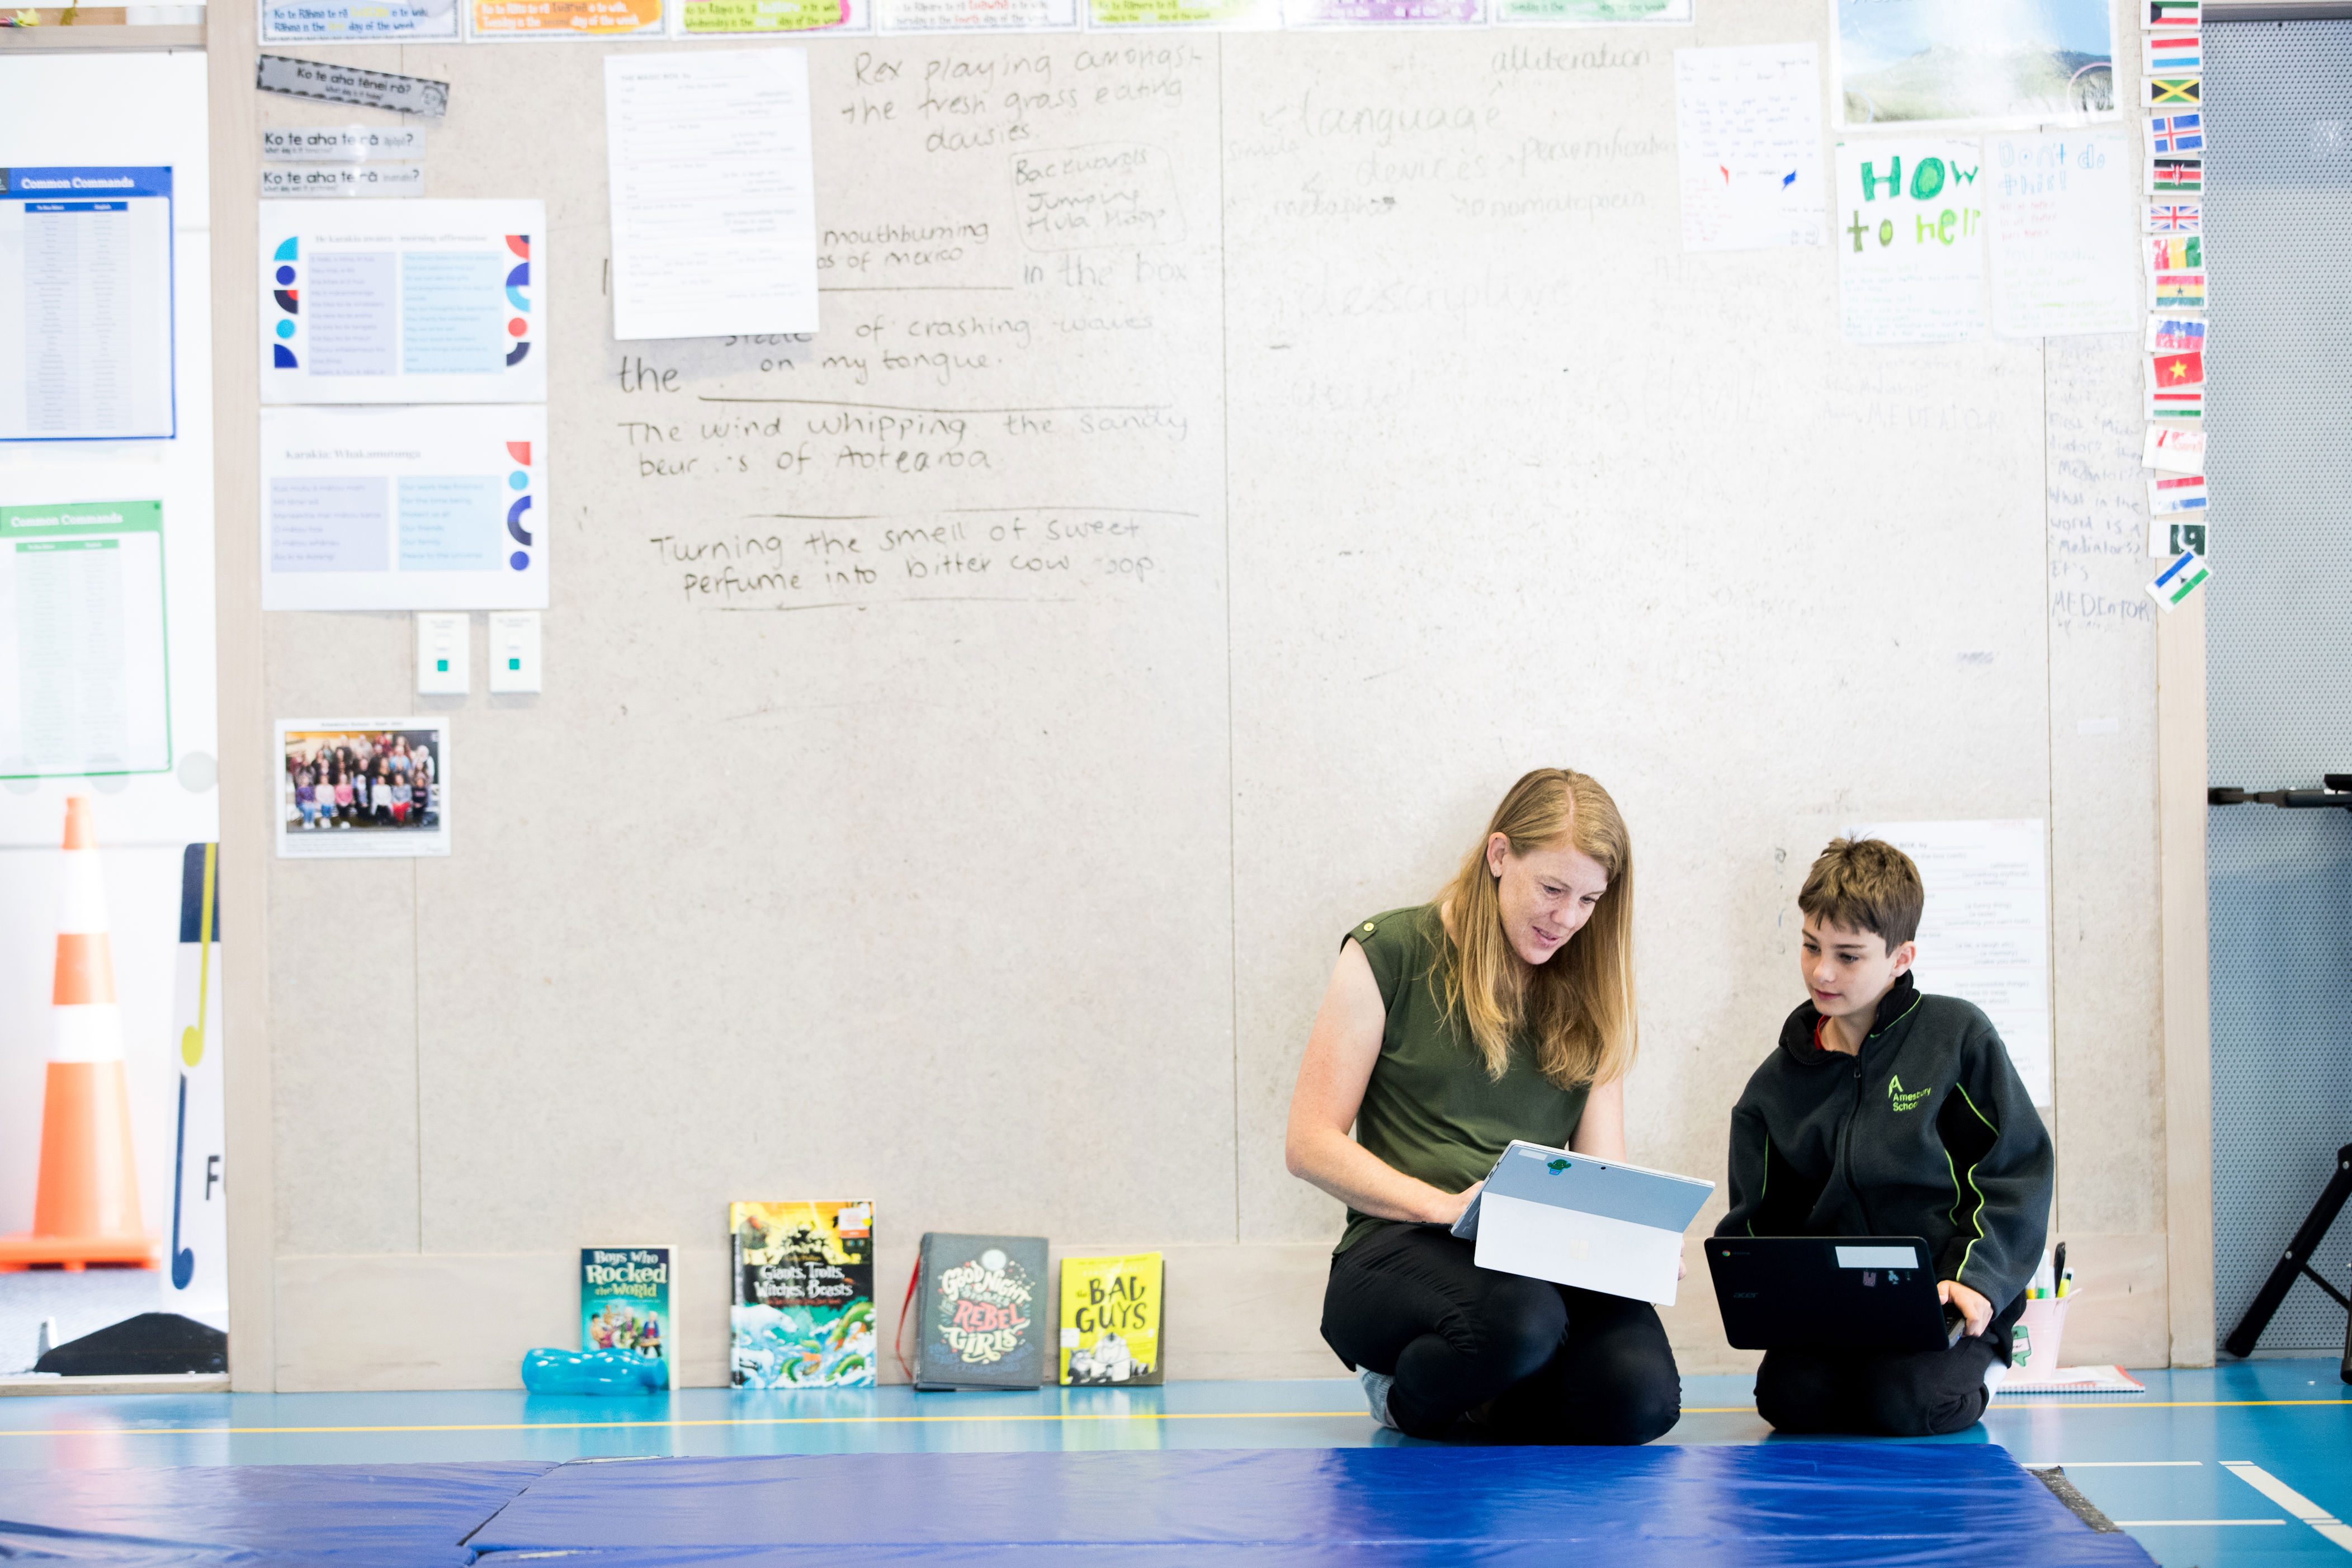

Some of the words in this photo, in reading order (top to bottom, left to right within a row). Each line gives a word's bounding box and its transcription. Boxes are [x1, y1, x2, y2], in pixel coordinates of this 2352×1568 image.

[854, 51, 904, 86] Rex
[924, 54, 1051, 94] playing
[1074, 44, 1203, 82] amongst
[1491, 42, 1650, 75] alliteration
[840, 96, 896, 125] the
[918, 84, 986, 120] fresh
[1005, 85, 1078, 121] grass
[1094, 79, 1183, 109] eating
[265, 133, 284, 145] Ko
[287, 133, 302, 145] te
[308, 133, 337, 145] aha
[2077, 144, 2105, 170] do
[21, 178, 72, 190] Common
[72, 176, 135, 189] Commands
[263, 172, 282, 184] Ko
[287, 171, 301, 184] te
[306, 171, 336, 184] aha
[1846, 209, 1893, 253] to
[847, 251, 872, 273] of
[1023, 263, 1044, 285] in
[1057, 253, 1113, 287] the
[1135, 251, 1188, 283] box
[855, 313, 886, 343] of
[906, 315, 1032, 350] crashing
[620, 353, 682, 395] the
[759, 356, 795, 374] on
[821, 353, 869, 386] my
[617, 422, 684, 446] The
[701, 414, 783, 440] wind
[807, 410, 967, 447] whipping
[1003, 412, 1056, 436] the
[1079, 408, 1189, 442] sandy
[776, 440, 812, 476] of
[835, 444, 993, 474] Aotearoa
[11, 516, 59, 528] Common
[61, 512, 124, 526] Commands
[649, 534, 783, 570] Turning
[804, 528, 862, 556] the
[879, 521, 967, 551] smell
[989, 516, 1028, 542] of
[823, 559, 879, 585] into
[904, 551, 992, 579] bitter
[1008, 554, 1071, 572] cow
[1892, 1101, 1919, 1112] Schoo
[1893, 1087, 1931, 1102] Amesbury
[585, 1262, 668, 1285] Rocked
[593, 1250, 628, 1266] Boys
[630, 1250, 659, 1265] Who
[953, 1299, 1026, 1333] REBEL
[1075, 1301, 1147, 1333] GUYS
